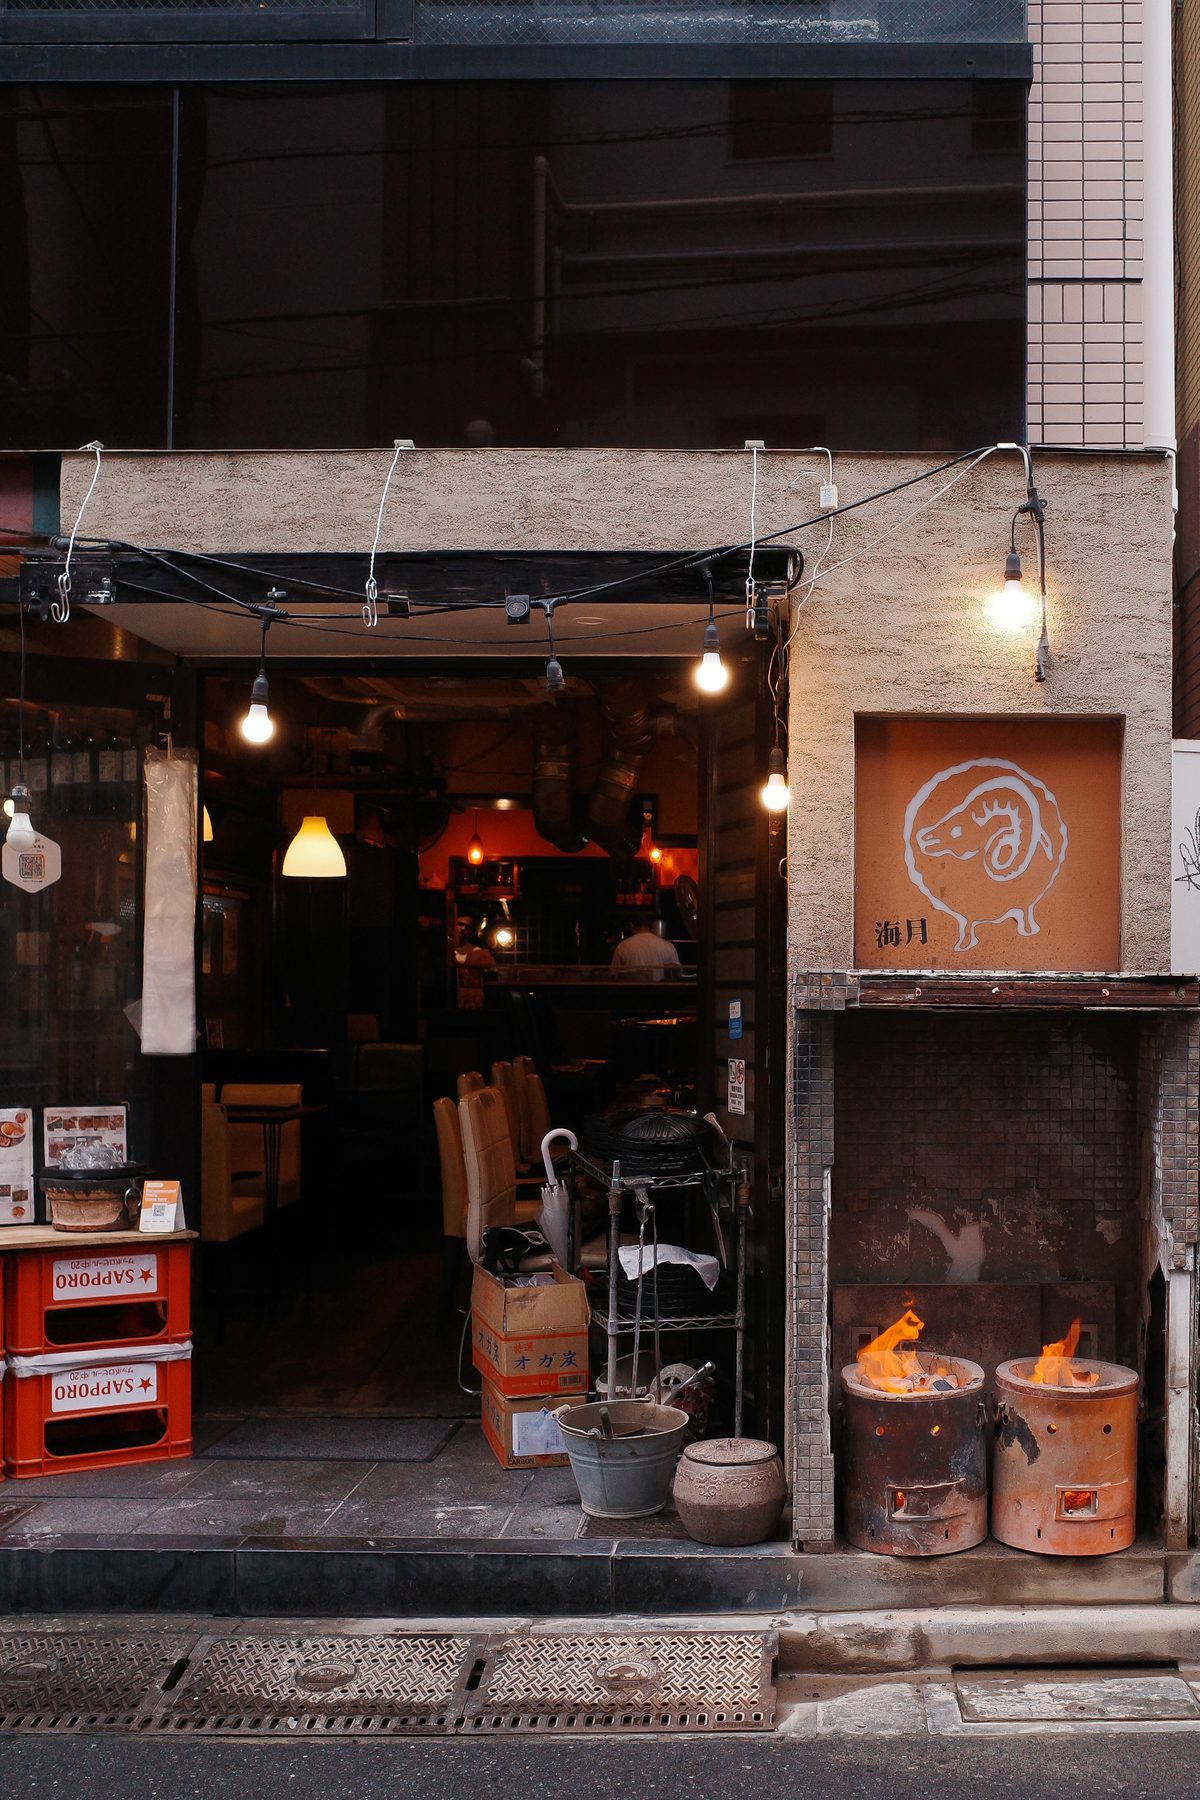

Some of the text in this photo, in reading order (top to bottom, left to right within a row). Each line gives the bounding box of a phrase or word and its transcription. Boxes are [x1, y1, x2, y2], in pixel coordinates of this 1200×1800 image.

[874, 917, 928, 949] 海月
[55, 1268, 135, 1289] SAPPORO
[513, 1350, 579, 1370] オガ炭
[54, 1377, 134, 1401] SAPPORO
[507, 1457, 535, 1466] CARBON
